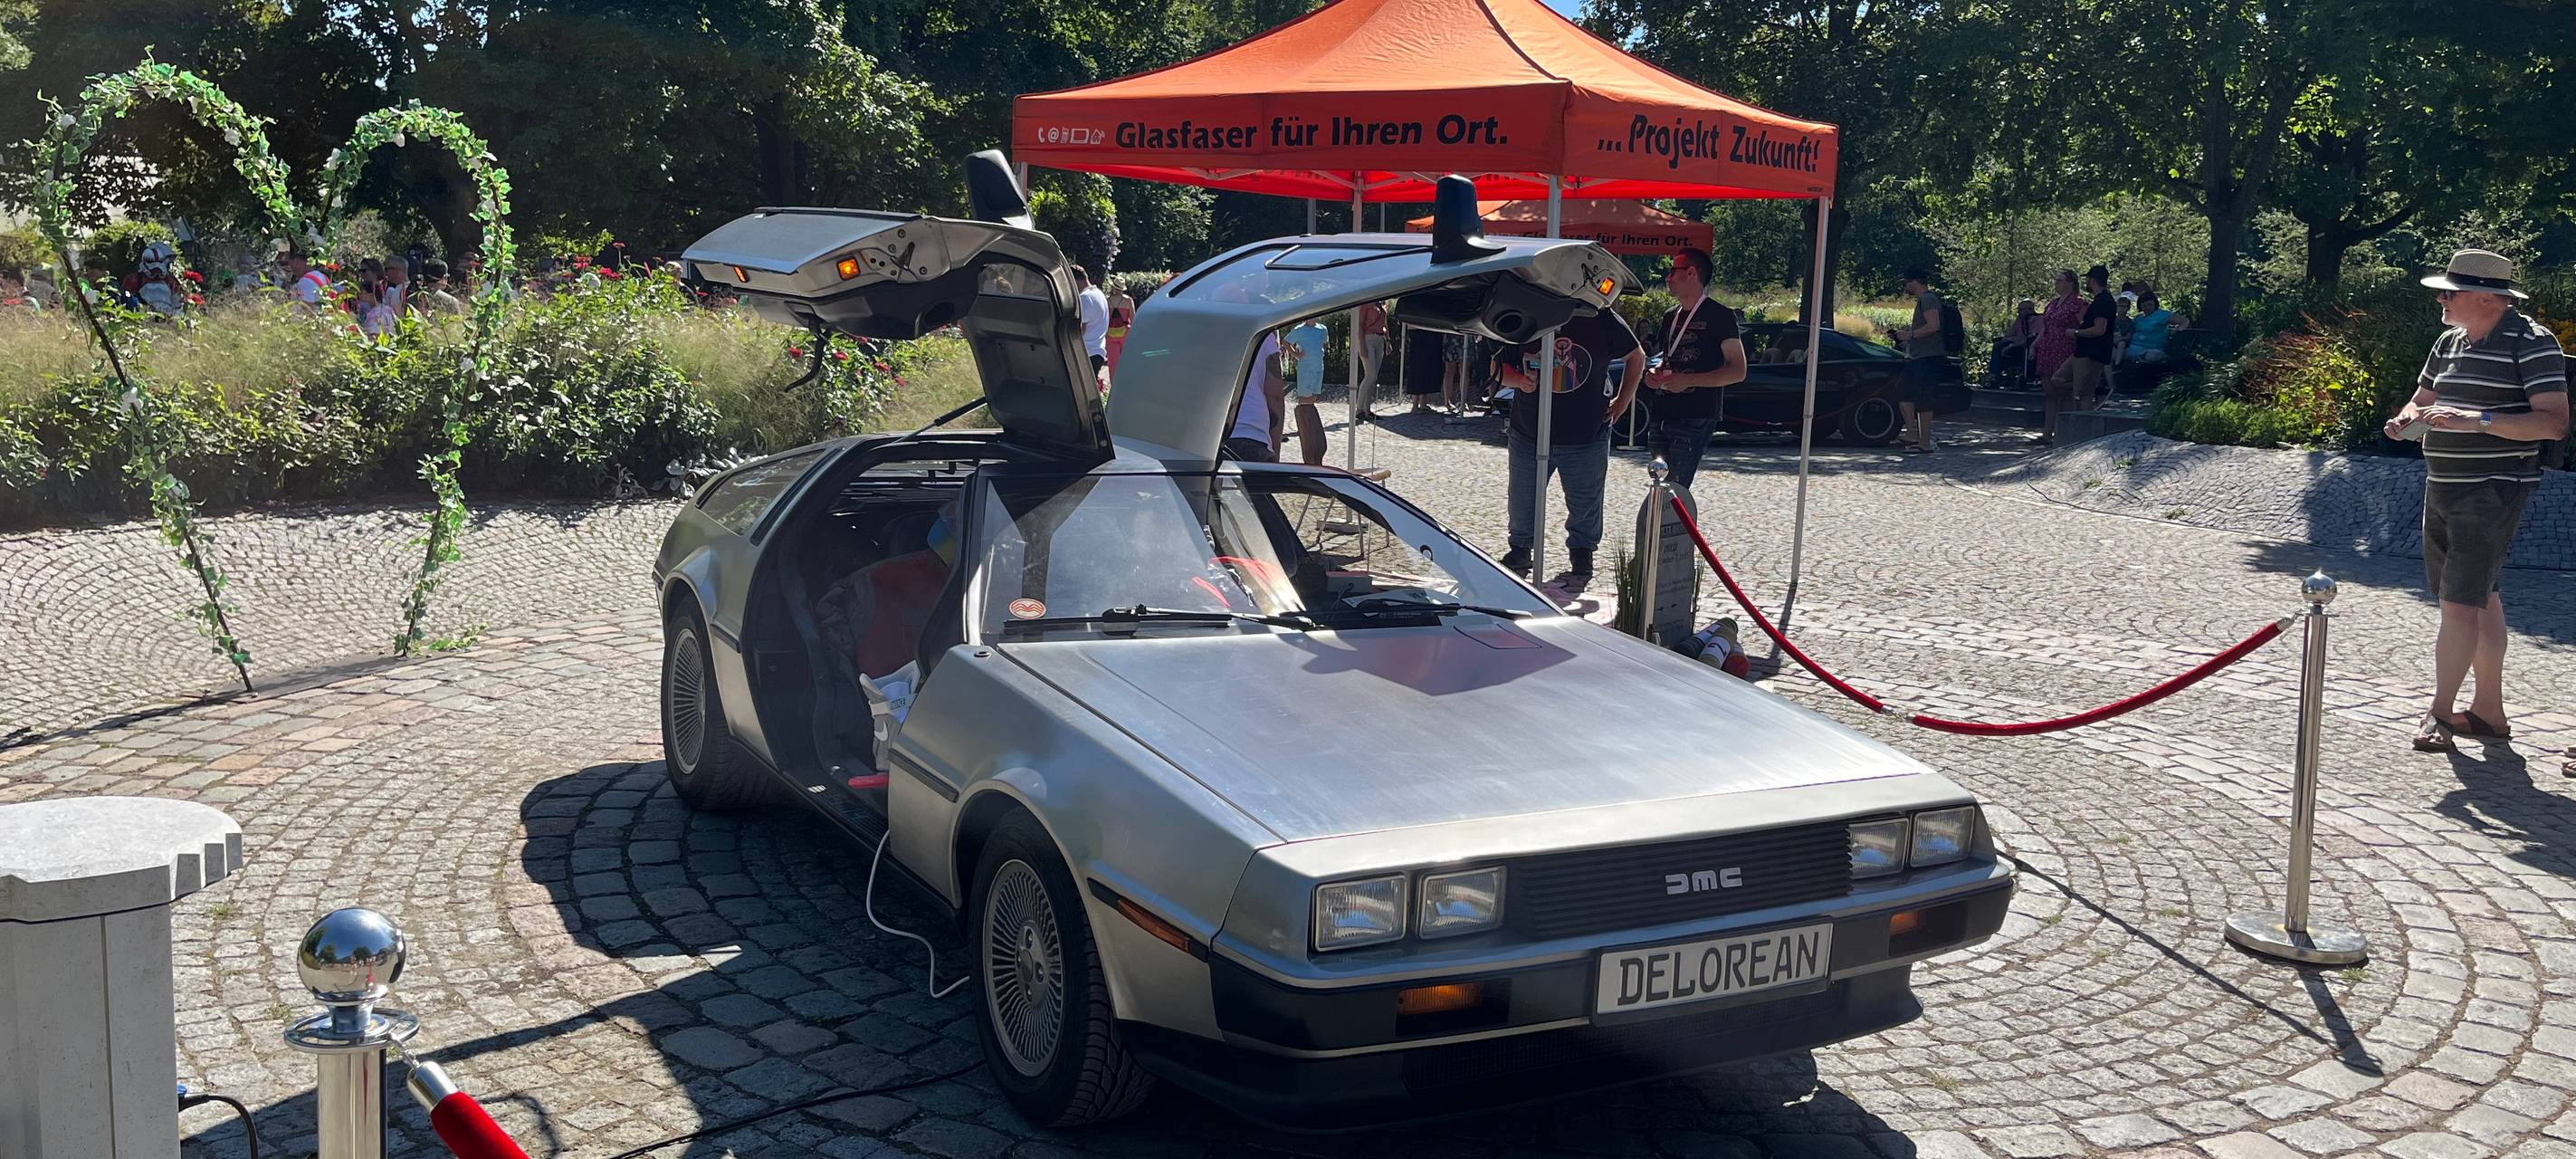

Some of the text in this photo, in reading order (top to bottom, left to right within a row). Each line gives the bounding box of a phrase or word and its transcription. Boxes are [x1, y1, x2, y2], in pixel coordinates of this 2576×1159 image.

[1115, 114, 1508, 148] Glasfaser für Ihren Ort.
[1628, 114, 1720, 169] Projekt
[1730, 125, 1821, 173] Zukunft!
[1622, 234, 1659, 245] Ihren
[1665, 235, 1693, 246] Ort.
[1665, 867, 1743, 896] DMC
[1617, 931, 1819, 1007] DELOREAN
